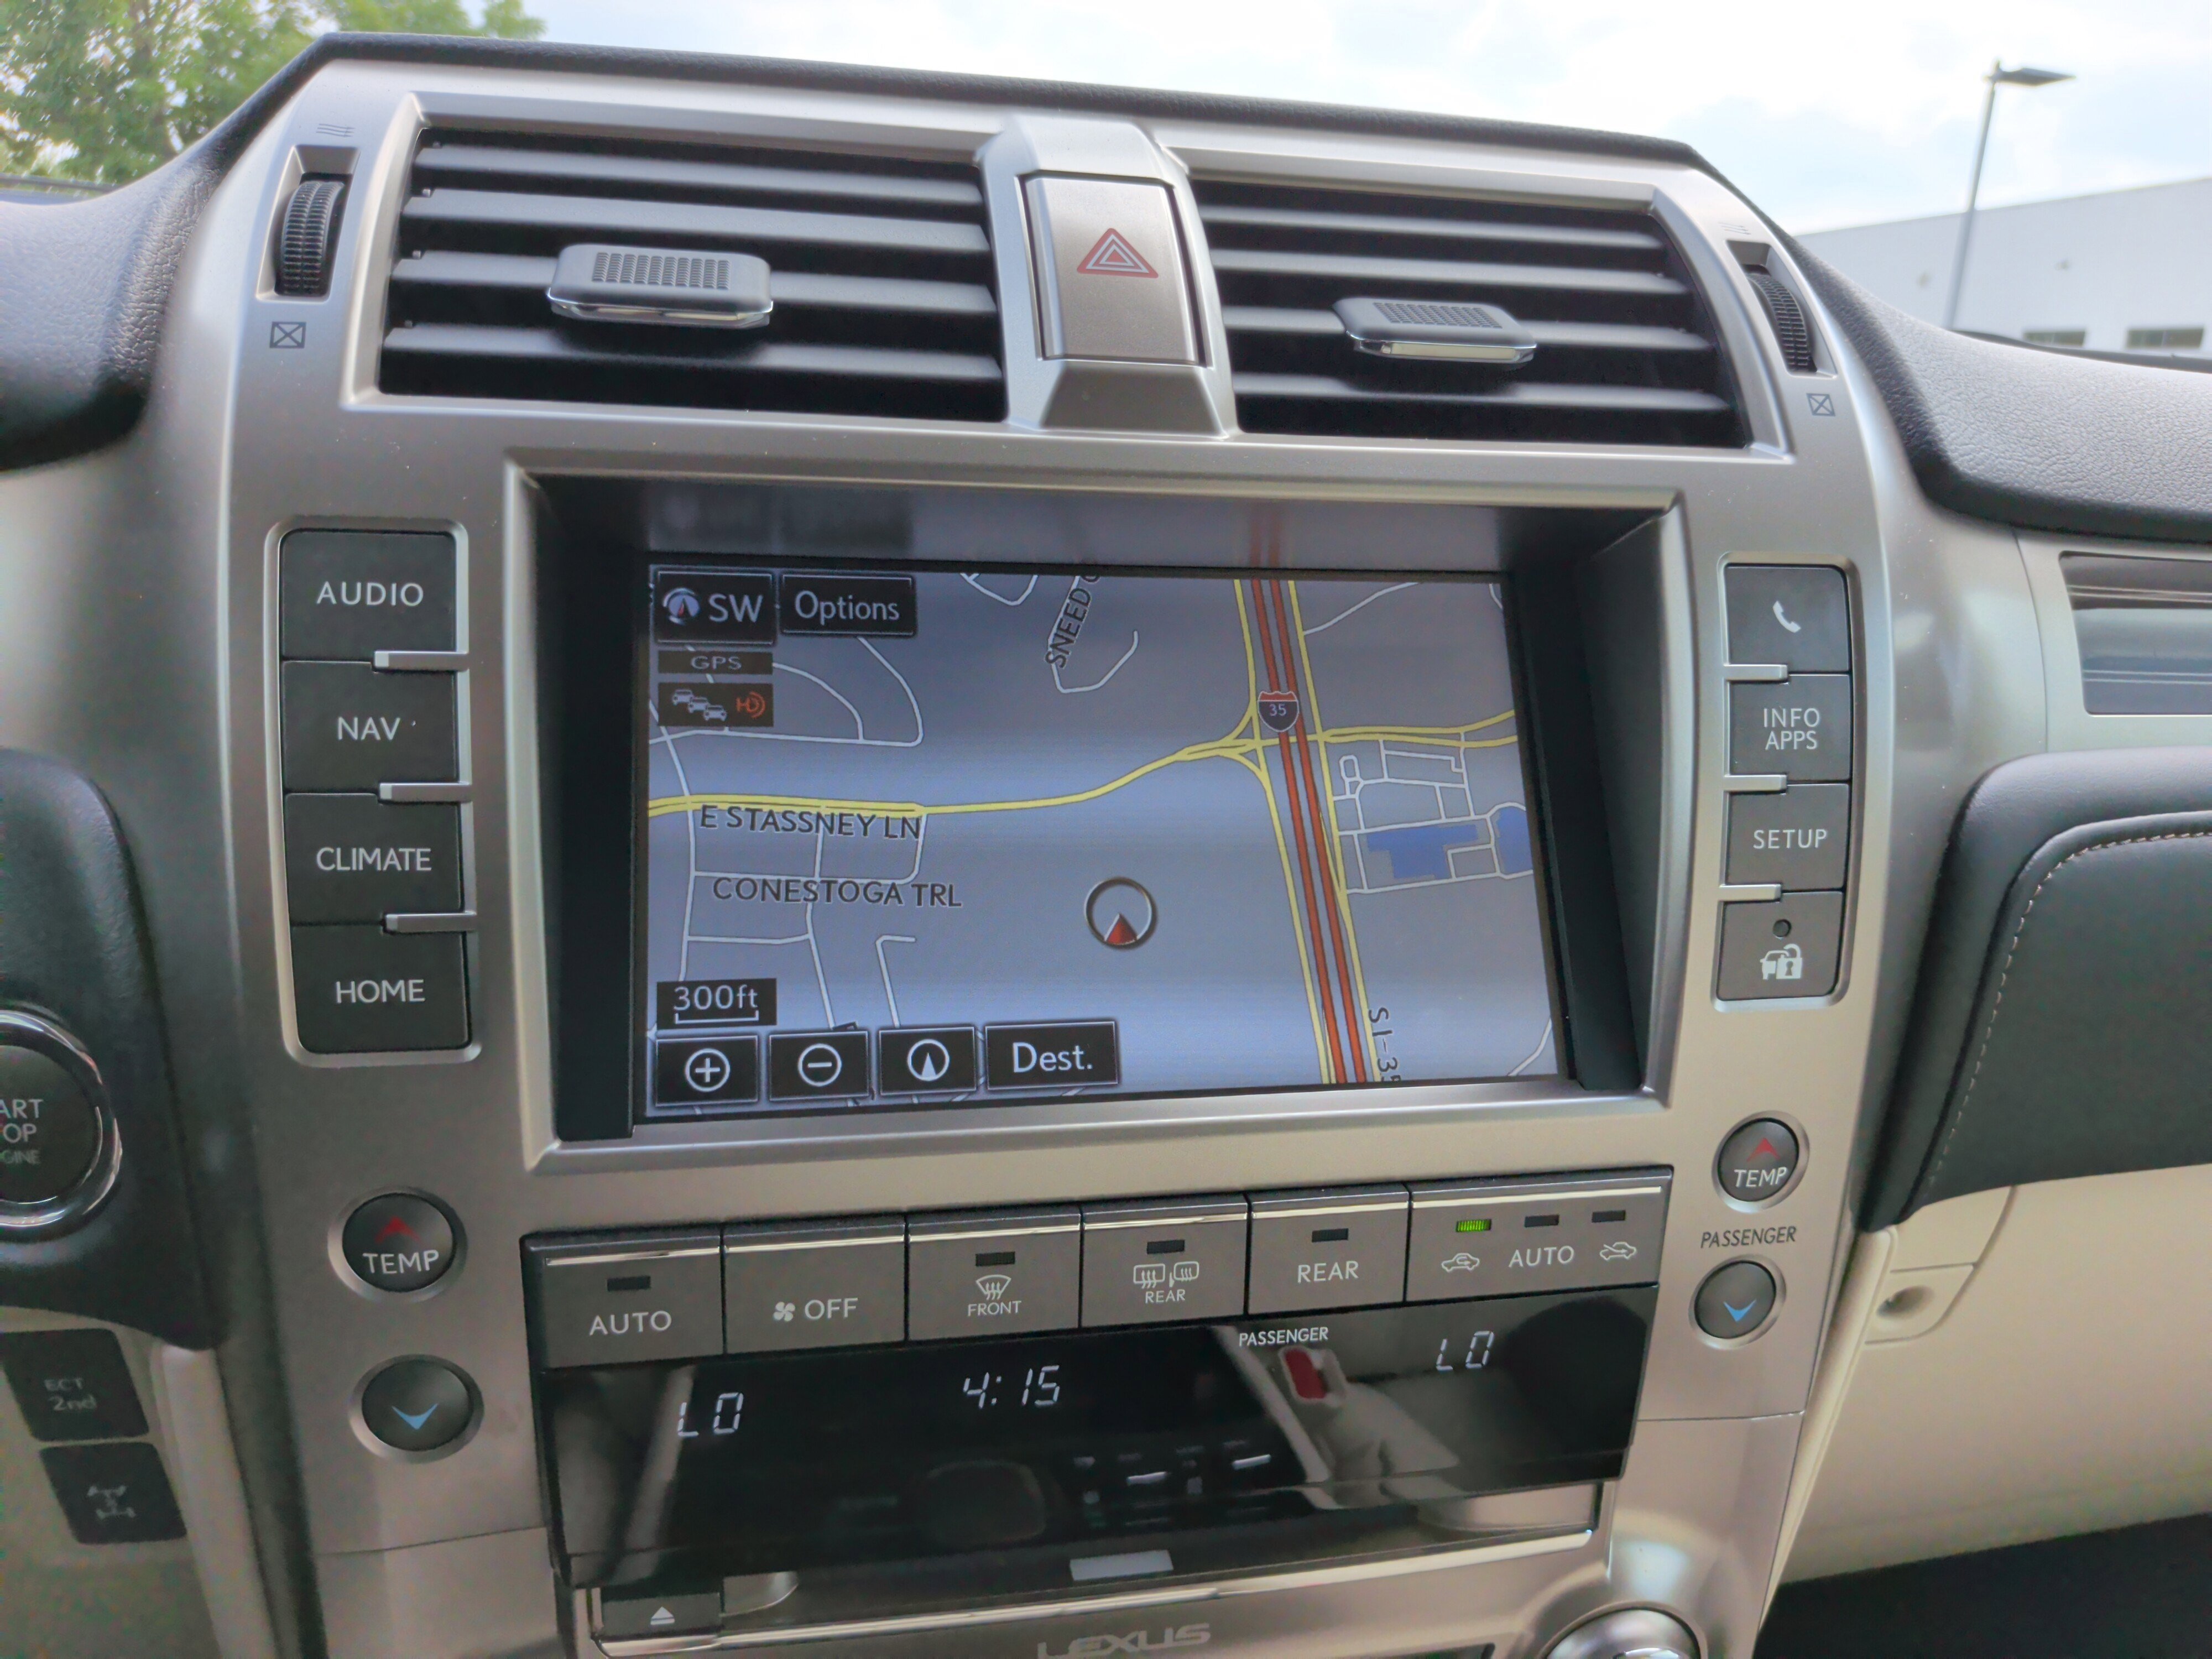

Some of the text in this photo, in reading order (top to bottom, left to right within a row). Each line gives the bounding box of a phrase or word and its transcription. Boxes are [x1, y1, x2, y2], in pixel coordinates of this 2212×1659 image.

[316, 581, 424, 607] AUDIO
[708, 593, 763, 626] SW
[795, 589, 900, 631] Options
[1045, 588, 1091, 669] SNEED
[690, 656, 743, 671] GPS
[1270, 704, 1286, 717] 35
[1764, 708, 1820, 728] INFO
[336, 717, 401, 740] NAV
[1765, 731, 1818, 750] APPS
[700, 805, 922, 840] E STASSNEY LN
[1752, 829, 1828, 849] SETUP
[316, 847, 432, 872] CLIMATE
[713, 877, 962, 907] CONESTOGA TRL
[335, 979, 426, 1004] HOME
[673, 984, 759, 1011] 300ft
[1012, 1041, 1093, 1073] Dest.
[1734, 1166, 1788, 1188] TEMP
[1700, 1225, 1797, 1249] PASSENGER
[362, 1248, 440, 1274] TEMP
[1507, 1245, 1576, 1270] AUTO
[1296, 1260, 1360, 1285] REAR
[1145, 1288, 1186, 1303] REAR
[804, 1297, 858, 1321] OFF
[967, 1300, 1021, 1318] FRONT
[588, 1310, 672, 1336] AUTO
[1238, 1326, 1329, 1348] PASSENGER
[962, 1364, 1061, 1409] 4:15
[1037, 1623, 1211, 1659] LEXUS
